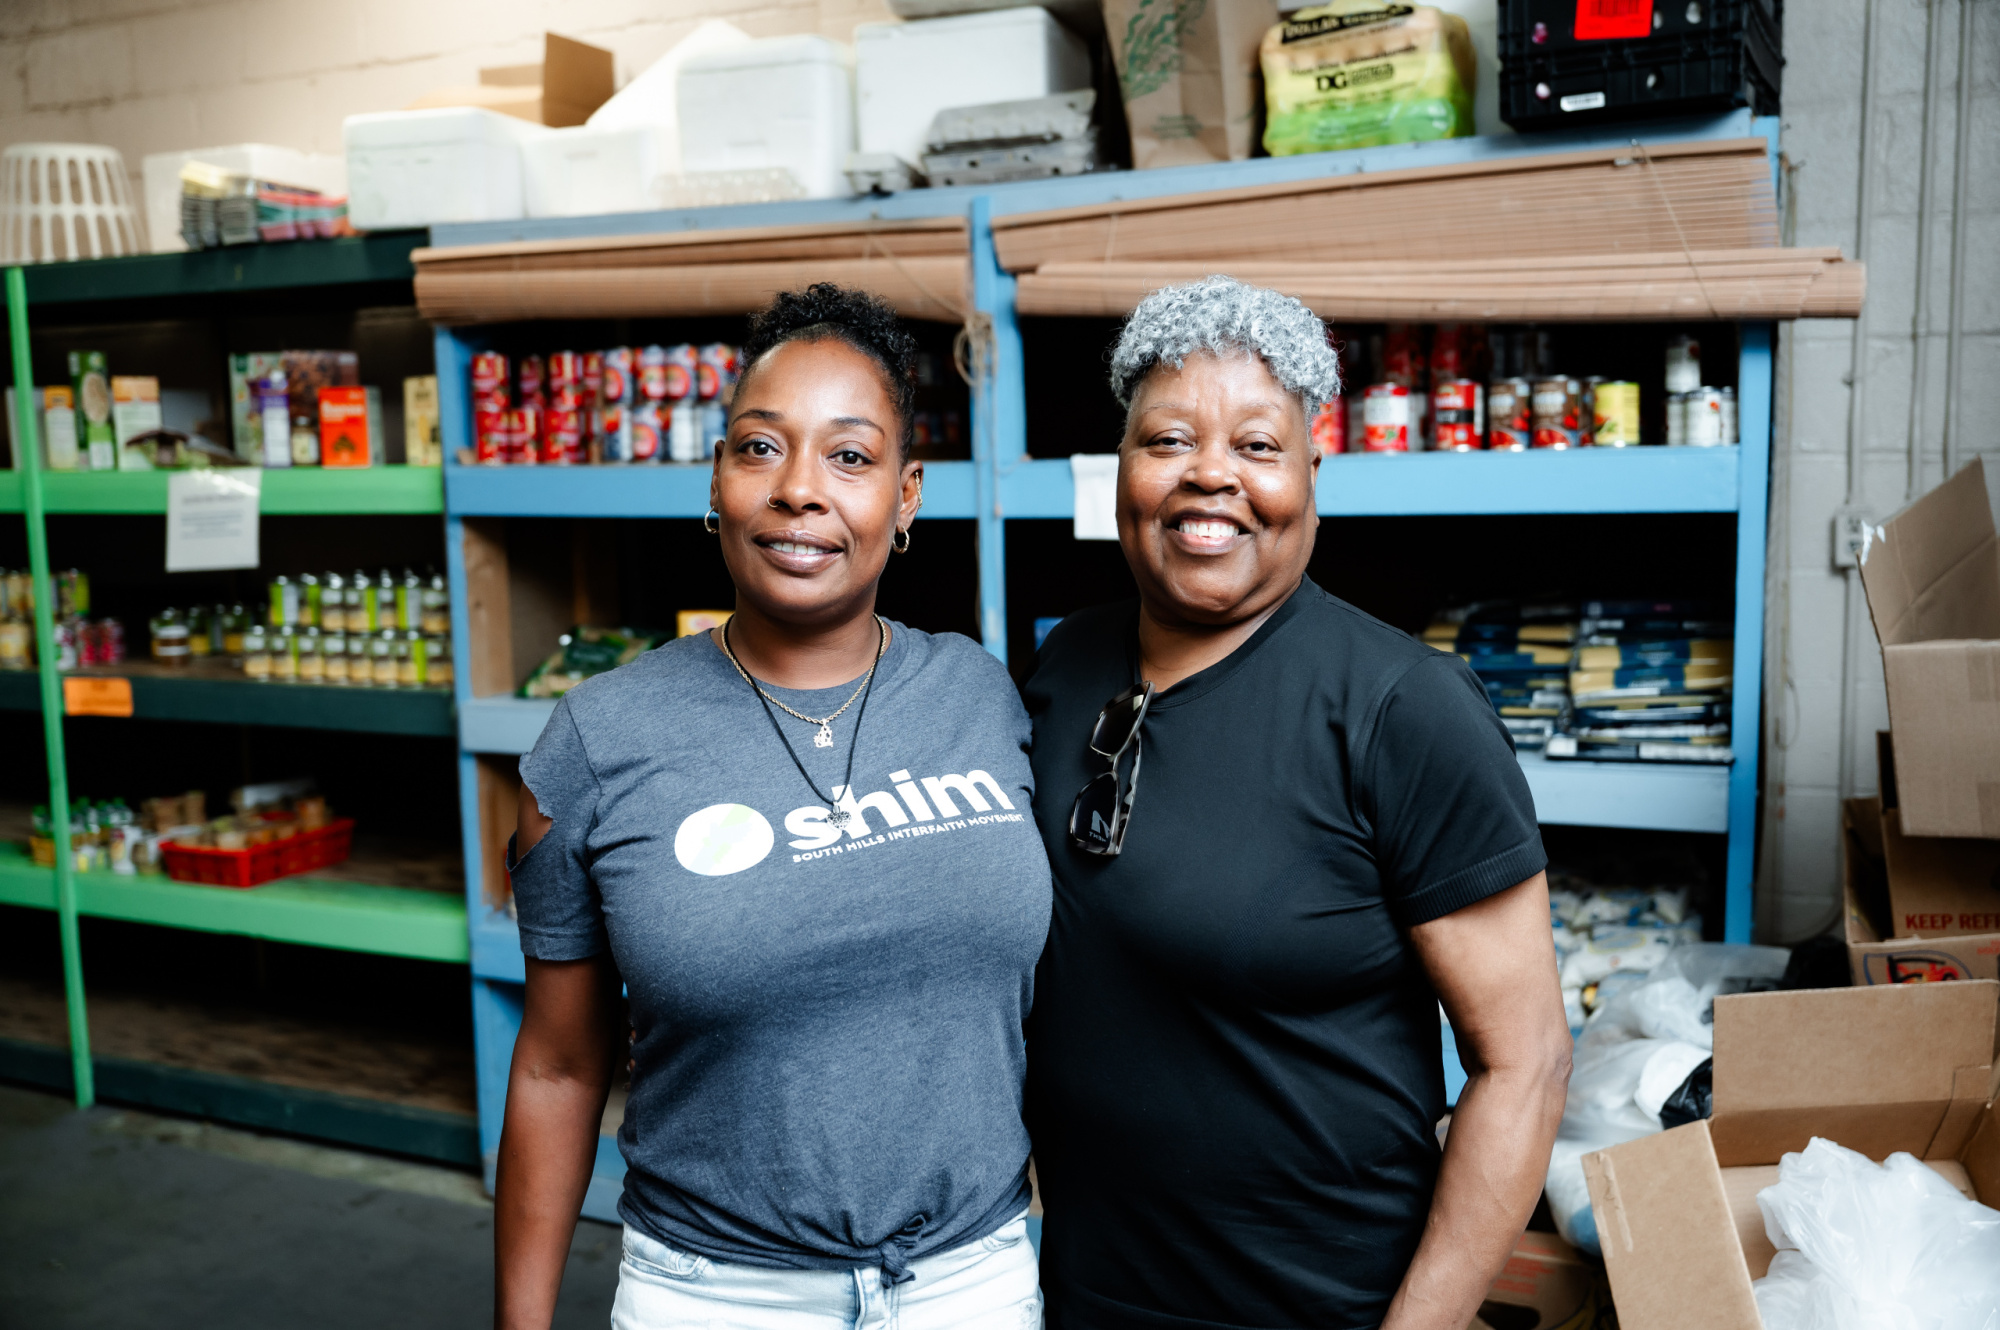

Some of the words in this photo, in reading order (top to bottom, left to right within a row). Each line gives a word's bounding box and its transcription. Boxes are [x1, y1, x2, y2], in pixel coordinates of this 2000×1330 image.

[1316, 71, 1347, 91] DG
[784, 768, 1016, 850] shim
[792, 845, 844, 863] SOUTH
[845, 834, 886, 852] HILLS
[887, 819, 967, 841] INTERFAITH
[967, 813, 1025, 827] MOVEMENT
[1905, 913, 1954, 930] KEEP
